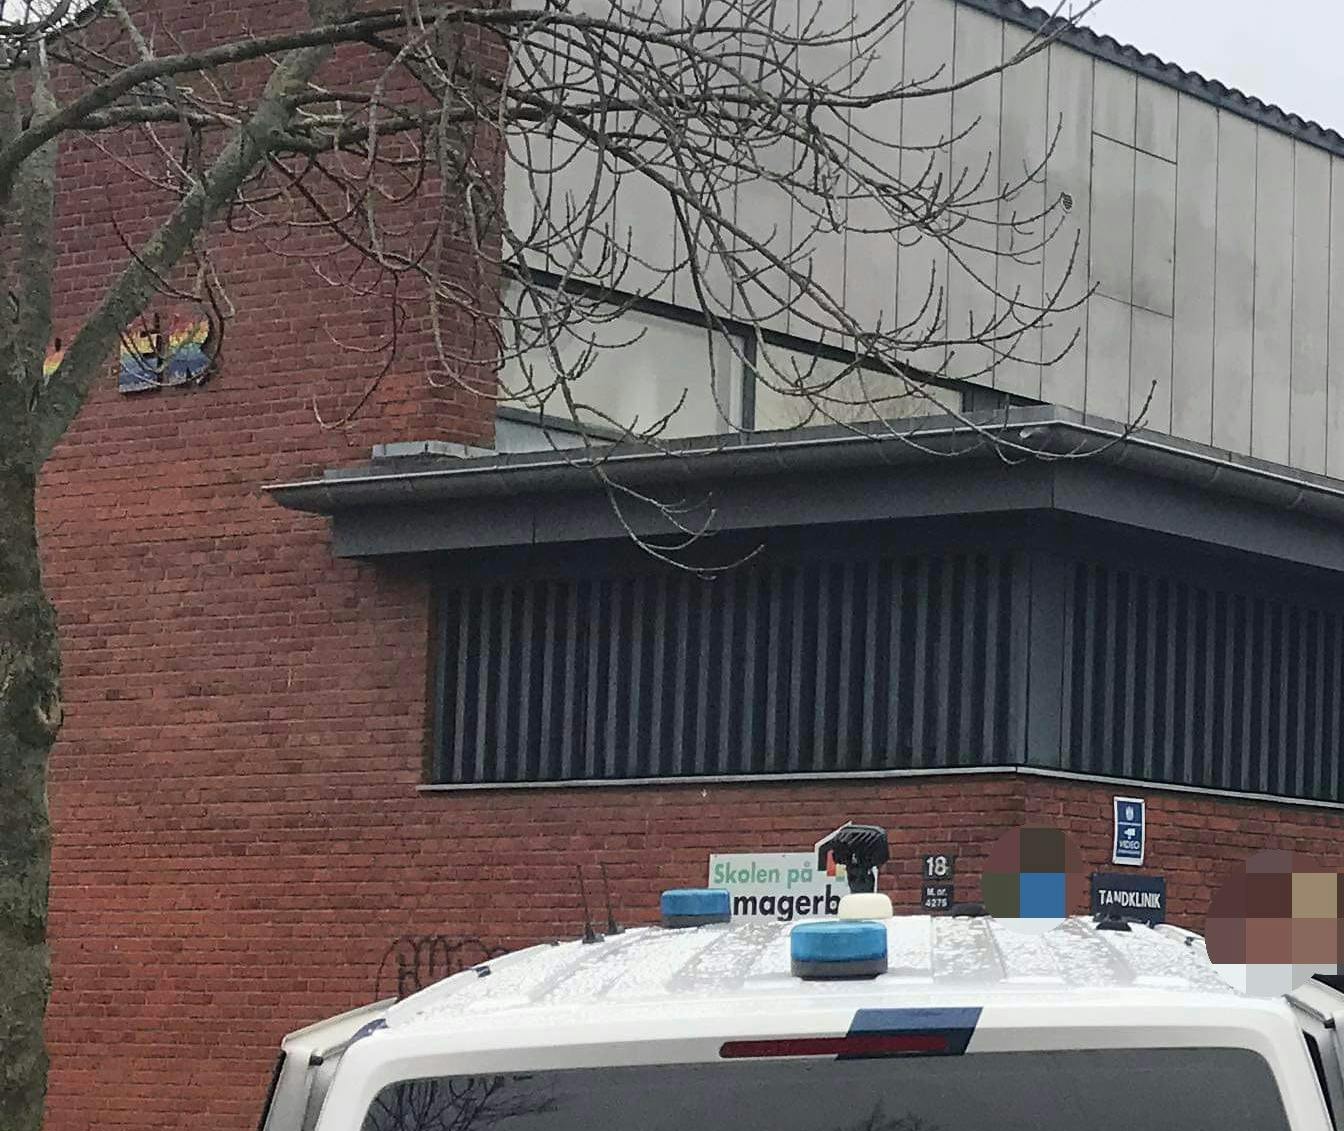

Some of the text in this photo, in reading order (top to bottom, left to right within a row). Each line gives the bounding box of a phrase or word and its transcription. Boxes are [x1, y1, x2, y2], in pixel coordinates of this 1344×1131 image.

[1119, 840, 1140, 849] VIDEO
[713, 861, 813, 889] Skolen på
[926, 856, 948, 876] 18
[733, 884, 841, 921] magerb
[1098, 889, 1161, 909] TANDKLINIK
